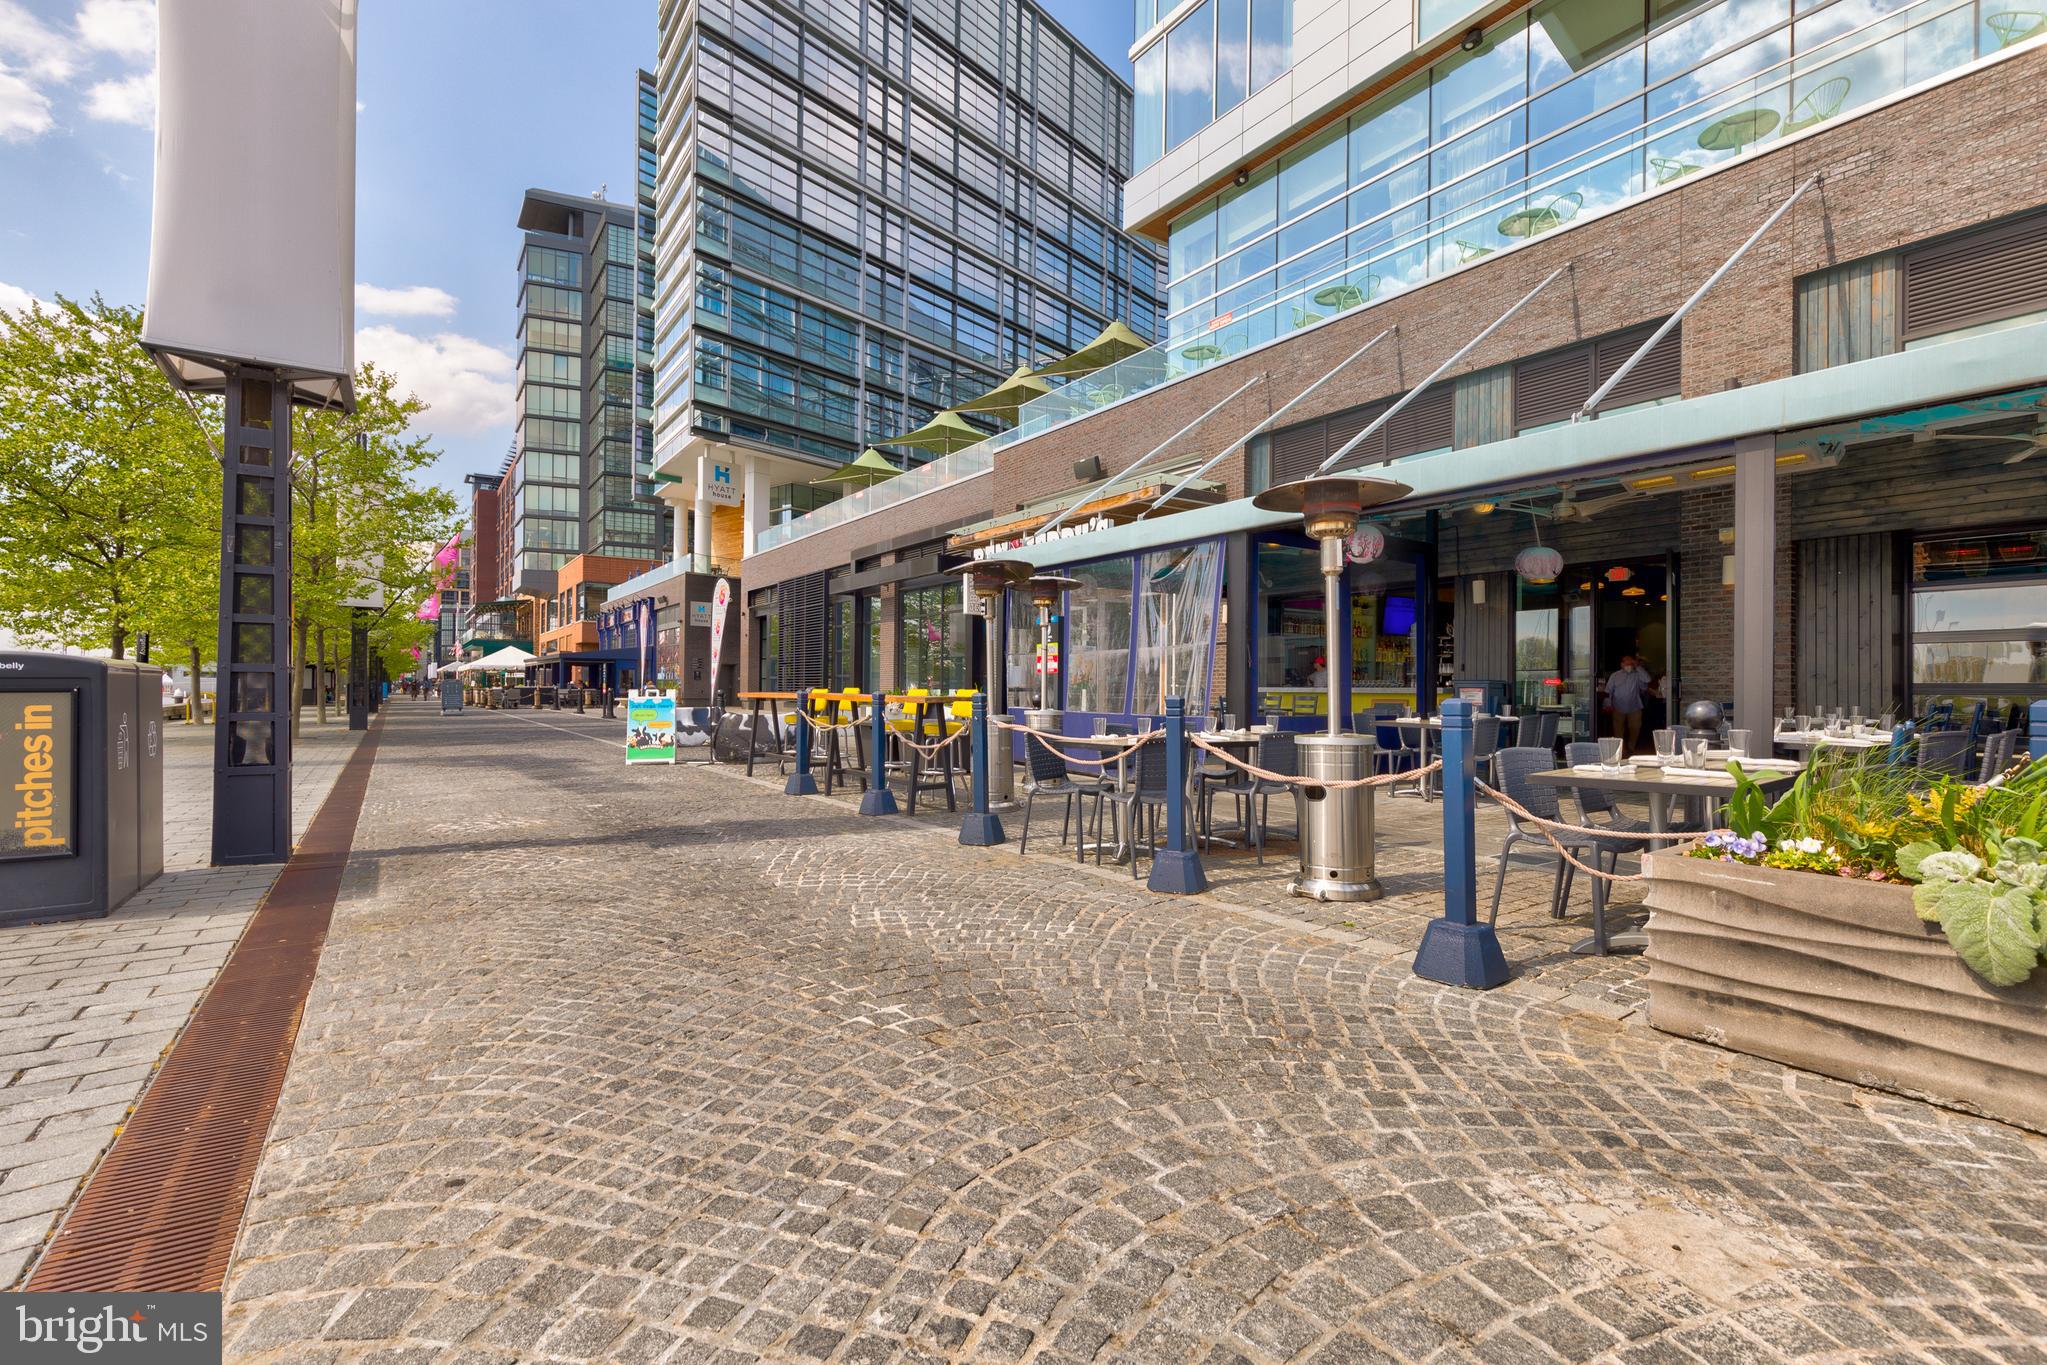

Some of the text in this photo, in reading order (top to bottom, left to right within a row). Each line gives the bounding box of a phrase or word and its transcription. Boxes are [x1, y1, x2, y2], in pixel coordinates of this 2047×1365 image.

[708, 484, 736, 494] HYATT
[712, 491, 732, 499] house
[15, 704, 65, 847] pitches in
